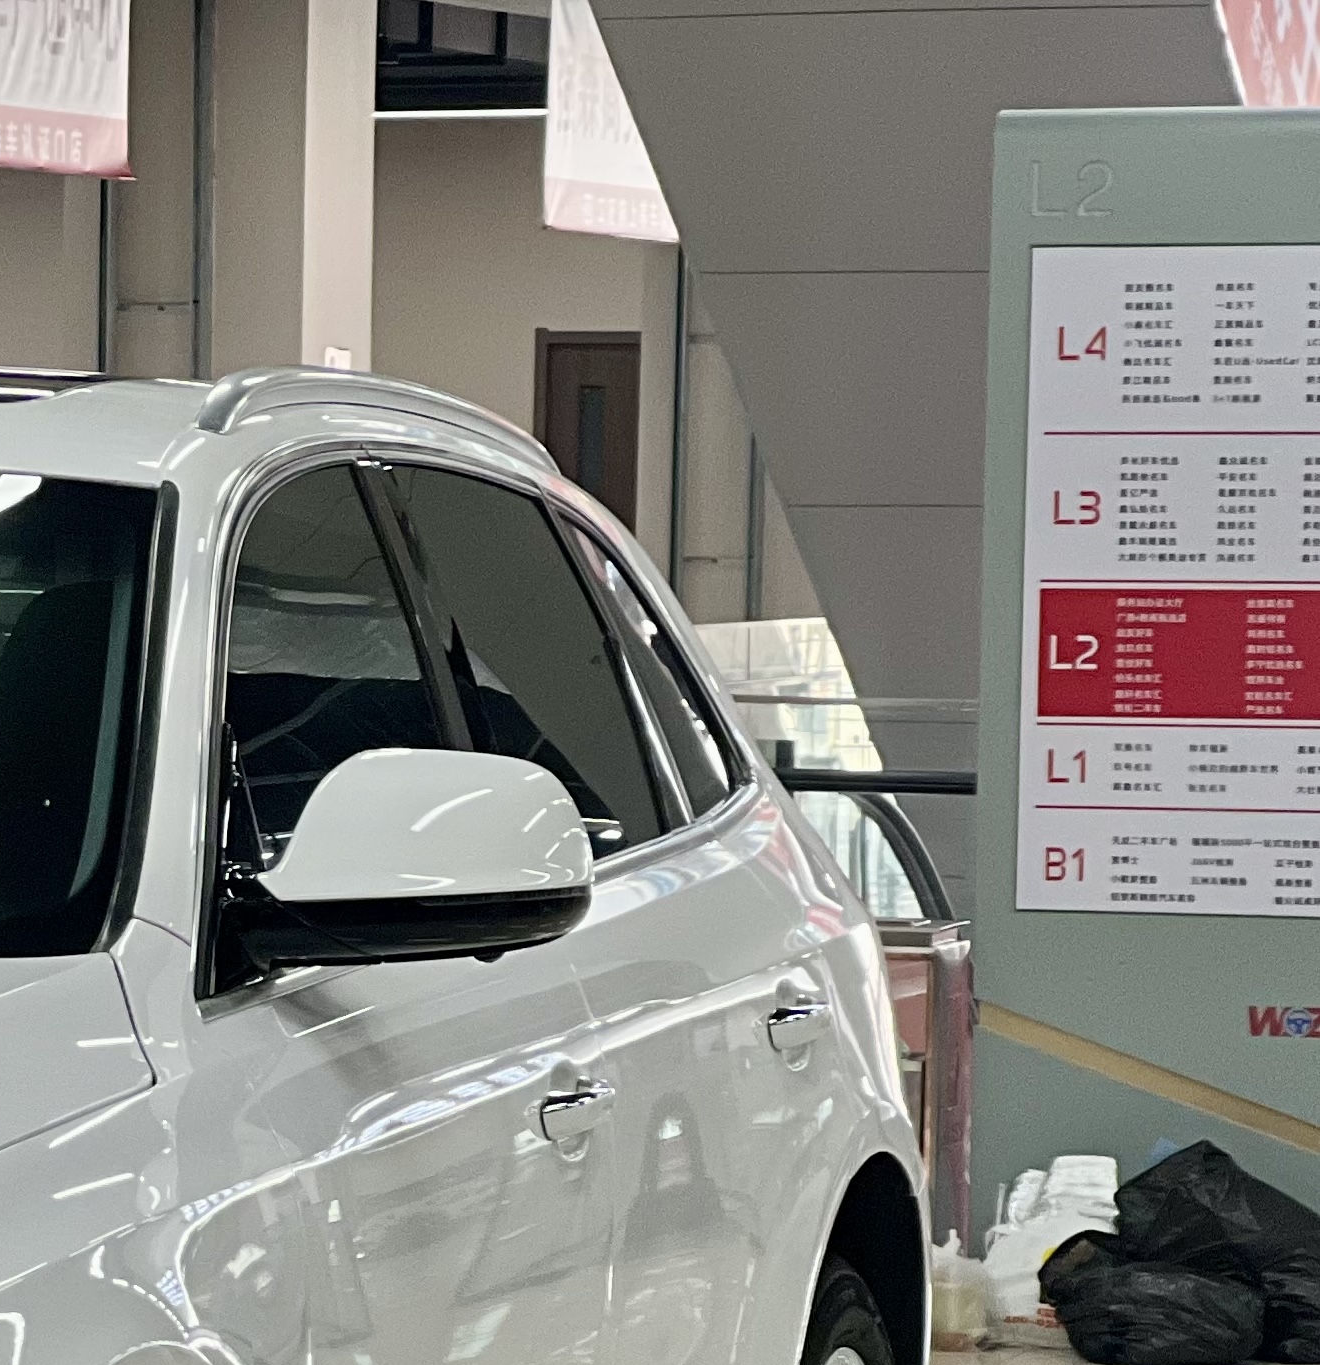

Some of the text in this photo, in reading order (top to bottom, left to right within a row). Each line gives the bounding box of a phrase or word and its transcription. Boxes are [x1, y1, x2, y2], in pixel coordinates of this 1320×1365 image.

[1030, 159, 1115, 217] L2
[1057, 326, 1108, 362] L4
[1053, 490, 1102, 525] L3
[1049, 635, 1099, 671] L2
[1046, 748, 1088, 784] L1
[1045, 847, 1085, 882] B1
